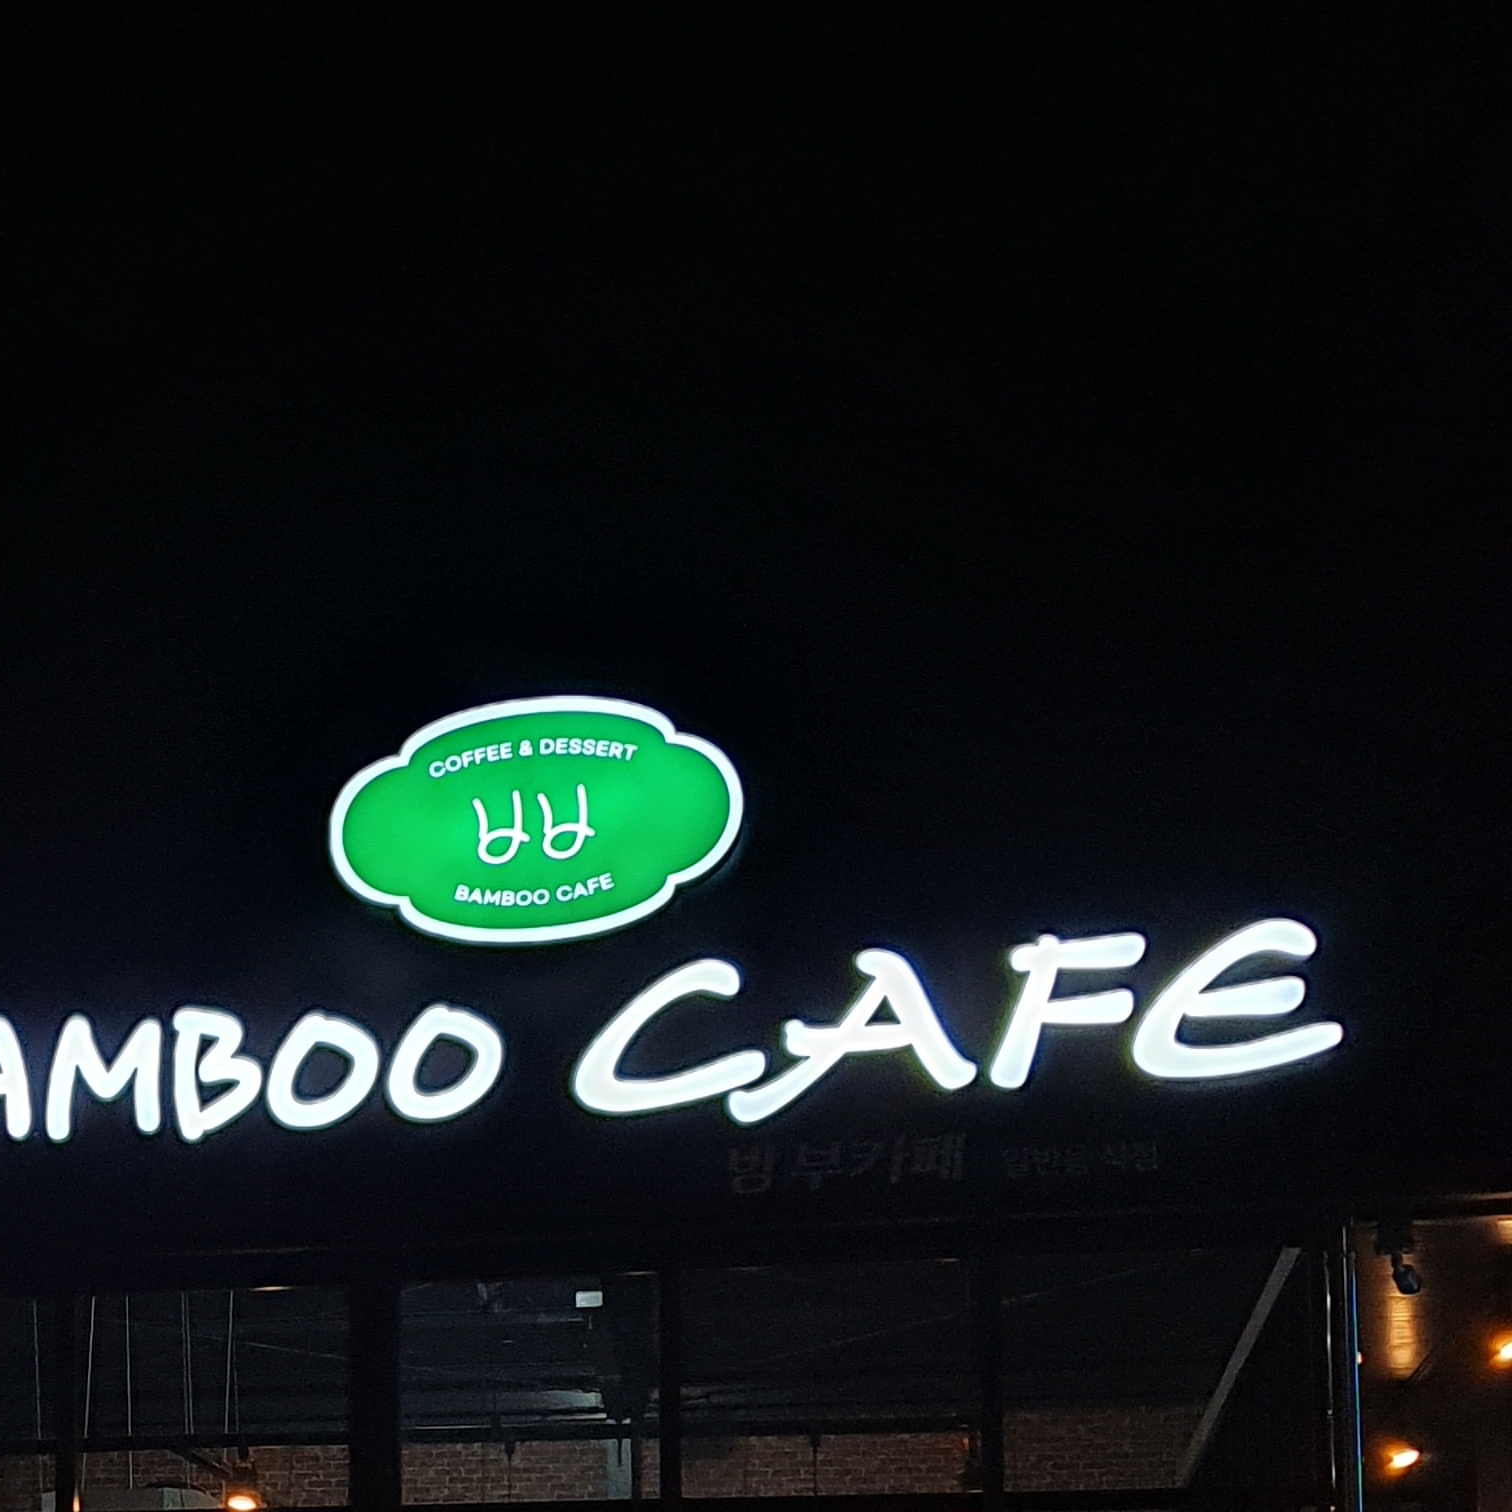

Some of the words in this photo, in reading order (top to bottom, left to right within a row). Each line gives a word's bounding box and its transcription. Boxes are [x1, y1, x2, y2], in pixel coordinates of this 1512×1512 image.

[428, 741, 513, 778] COFFEE
[519, 740, 533, 756] &
[539, 737, 638, 761] DESSERT
[454, 884, 550, 907] BAMBOO
[556, 873, 615, 903] CAFE
[570, 917, 1344, 1125] CAFE
